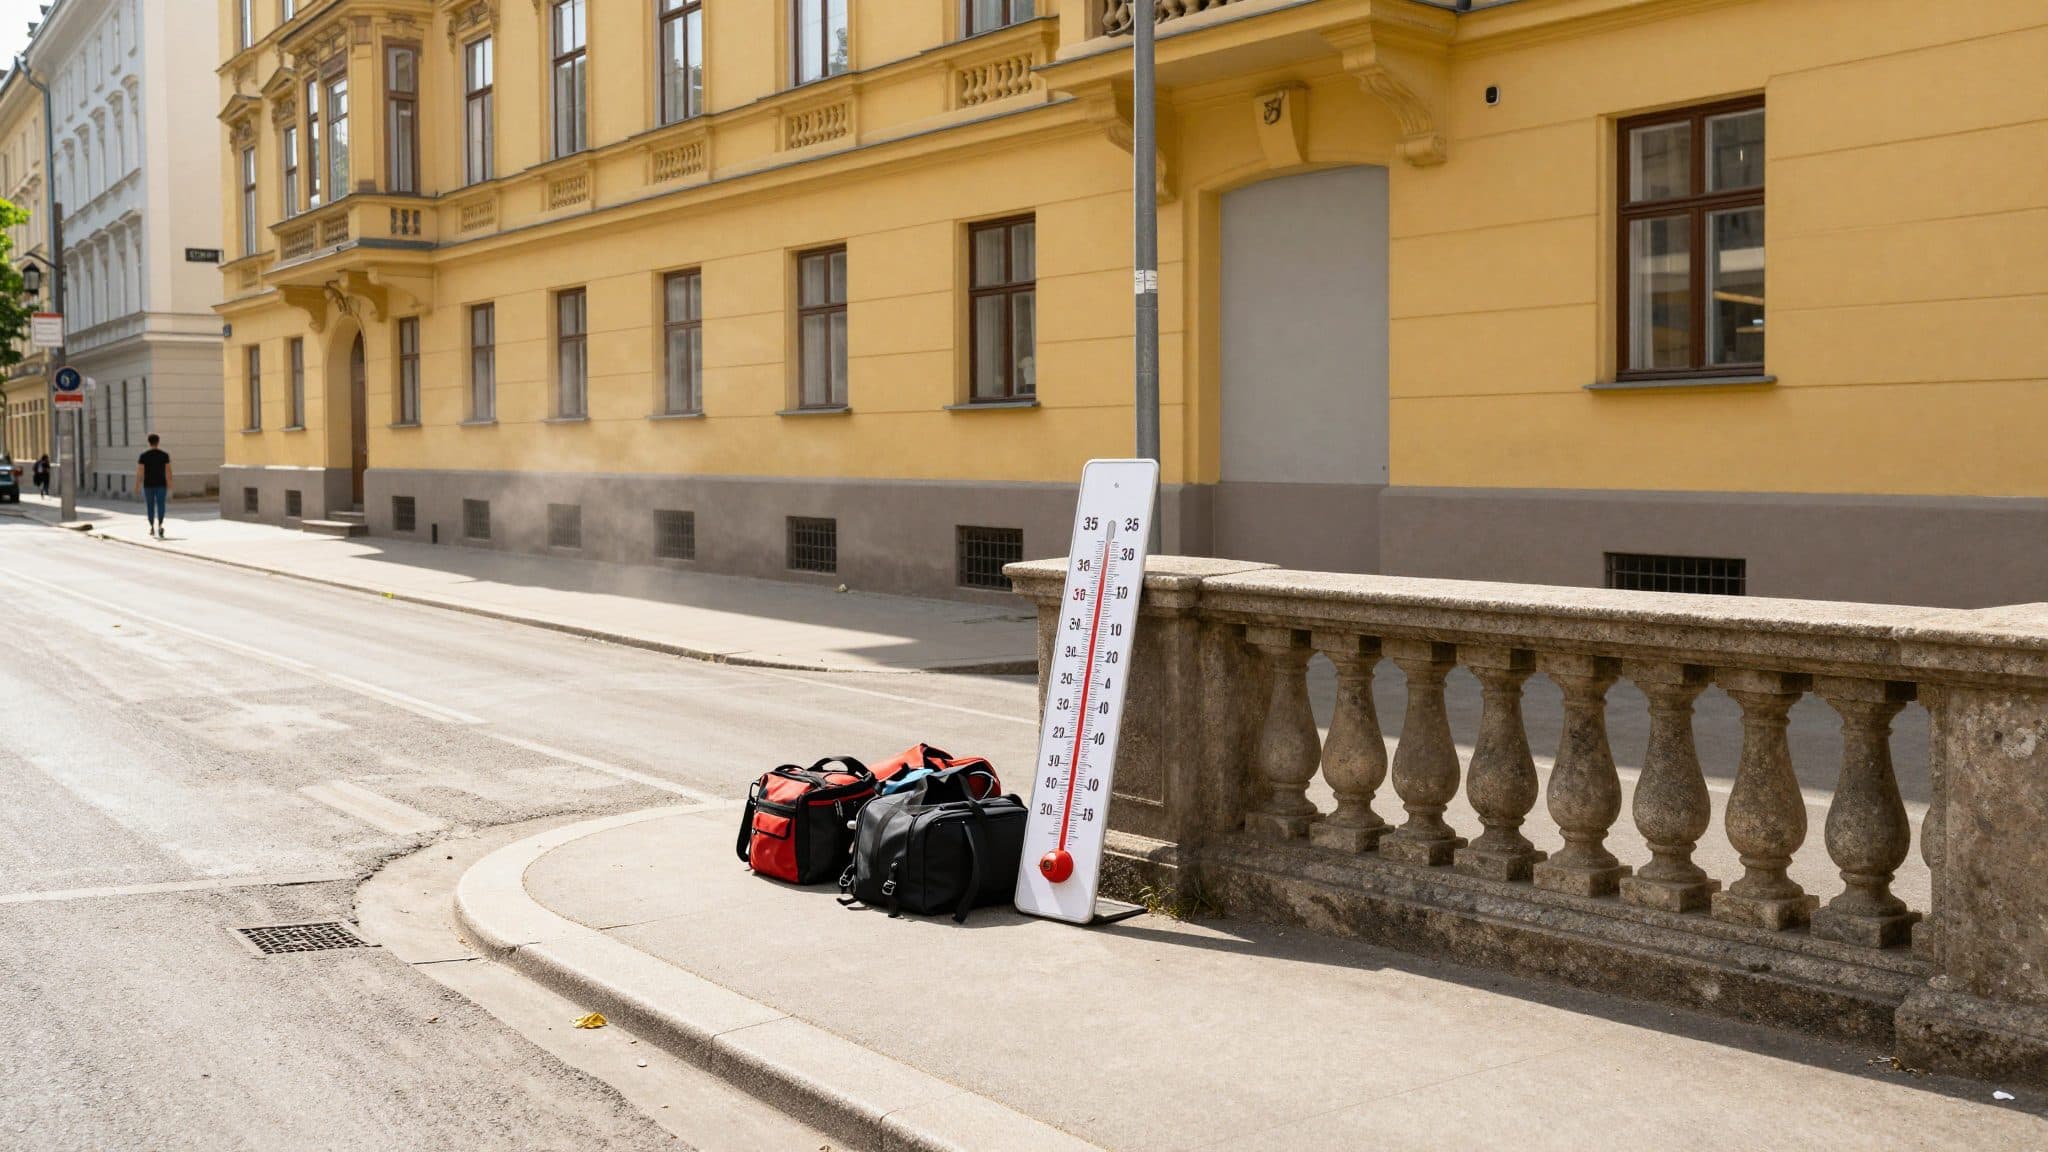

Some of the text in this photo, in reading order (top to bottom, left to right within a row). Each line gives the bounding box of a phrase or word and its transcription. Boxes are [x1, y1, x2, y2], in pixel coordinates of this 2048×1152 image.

[1083, 517, 1098, 531] 35
[1110, 624, 1122, 636] 10
[1105, 651, 1118, 664] 20
